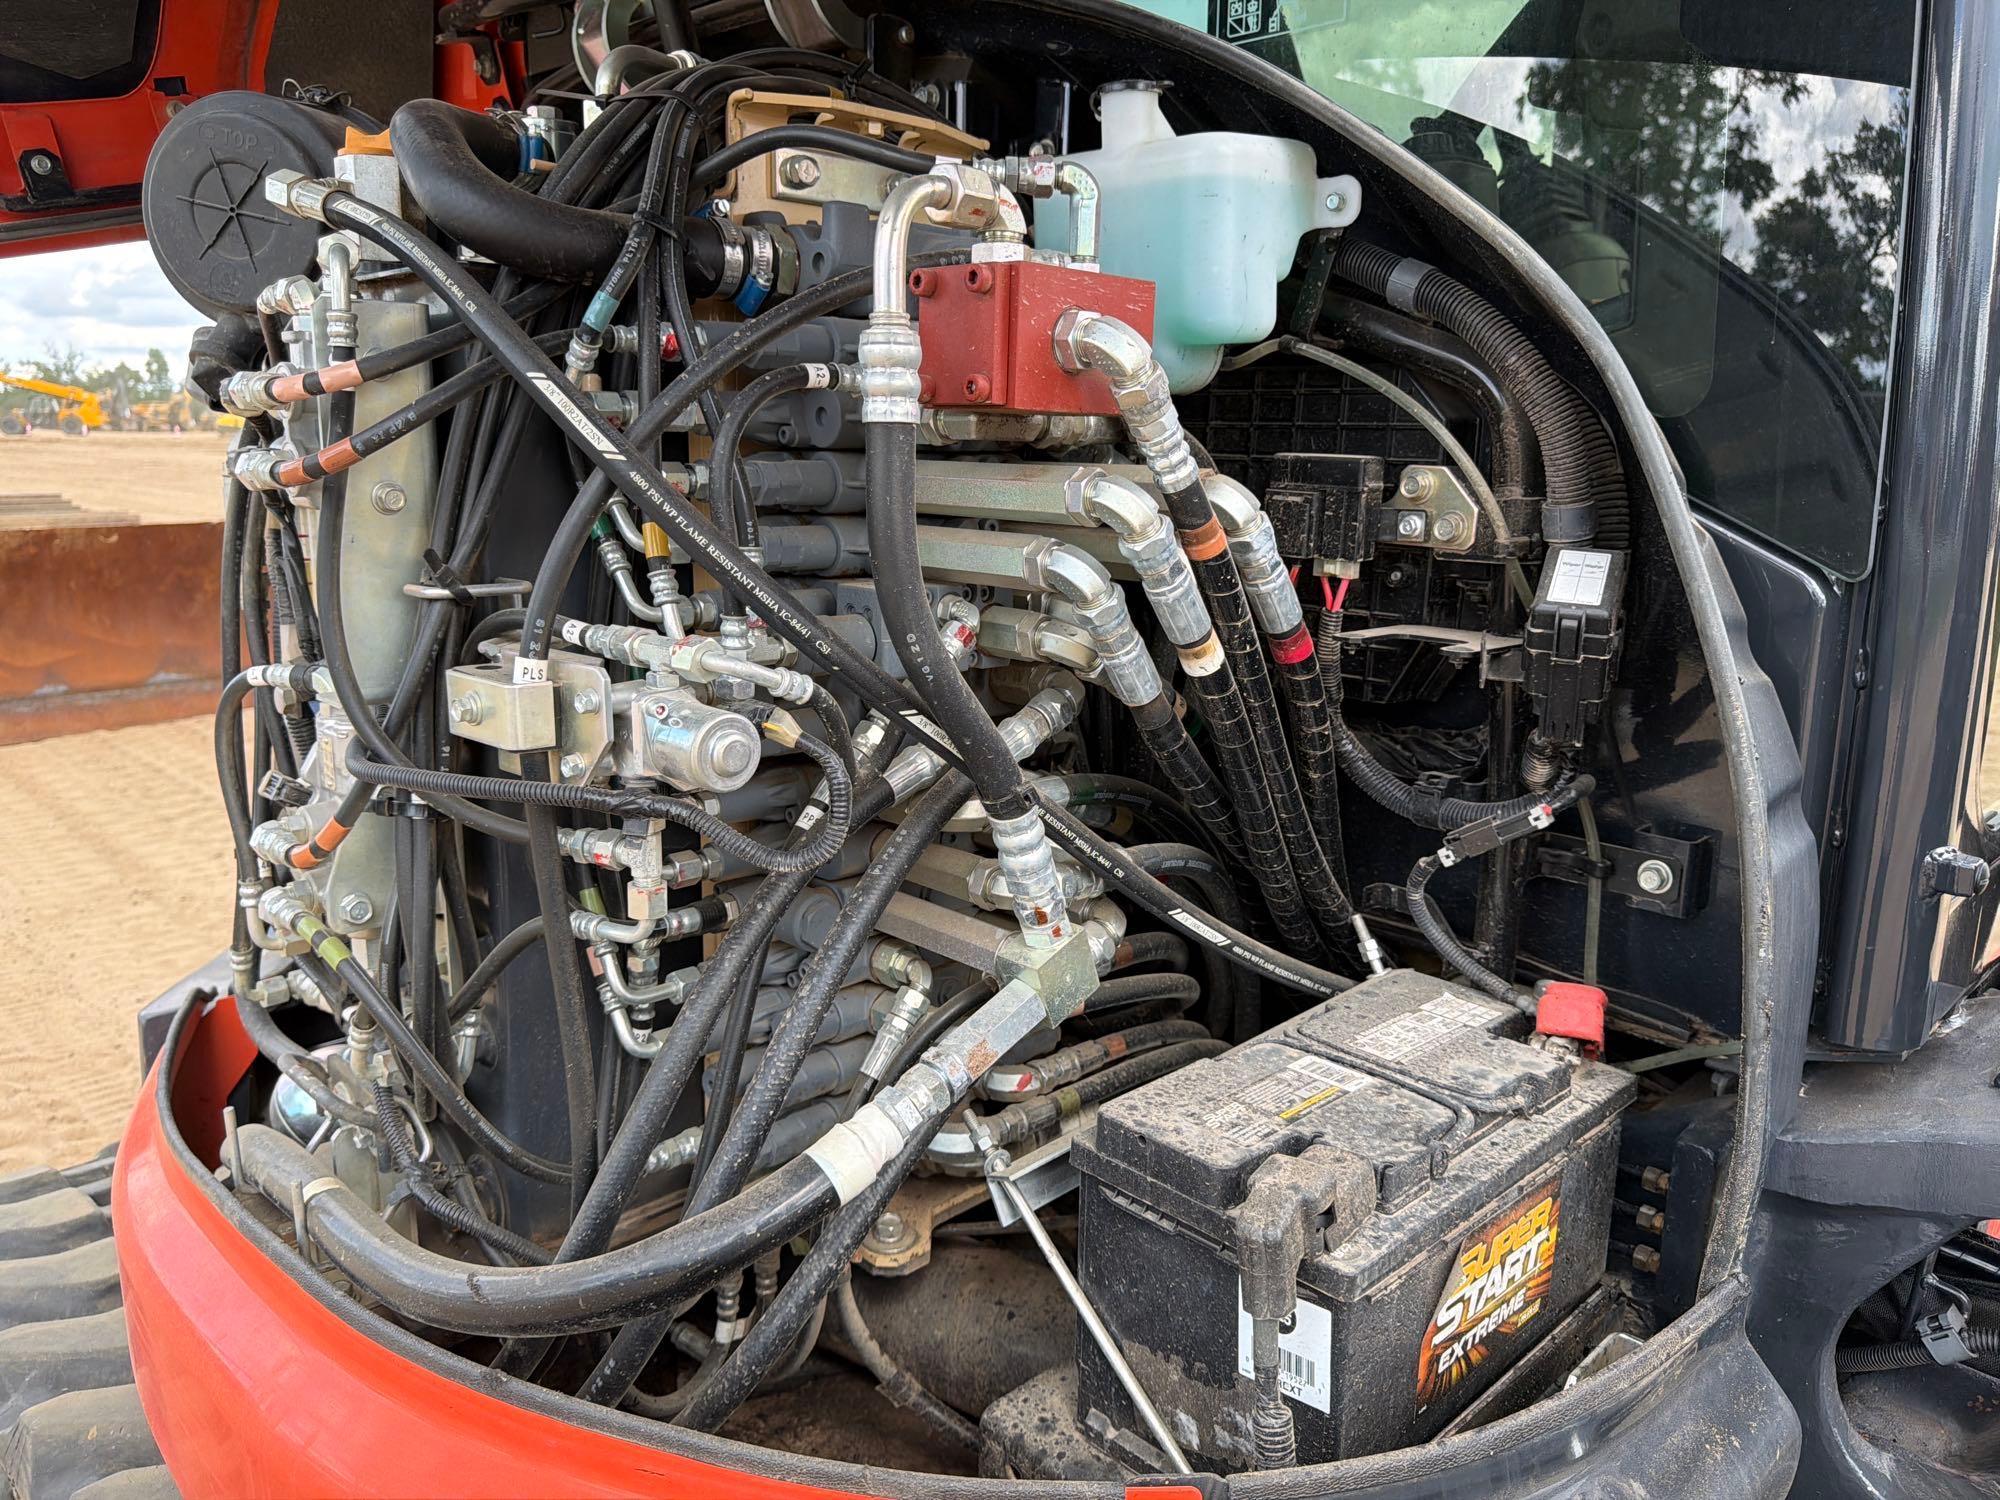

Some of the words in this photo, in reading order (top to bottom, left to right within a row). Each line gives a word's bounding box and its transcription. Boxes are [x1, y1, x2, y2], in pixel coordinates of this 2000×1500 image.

[222, 127, 258, 149] TOP
[413, 245, 437, 271] RESISTANT
[433, 266, 448, 283] MSHA
[465, 300, 477, 312] CSI
[557, 397, 604, 446] 100R2AT/2SN
[629, 469, 649, 492] 4800
[646, 488, 664, 506] PSI
[661, 501, 680, 520] WP
[675, 514, 709, 551] FLAME
[706, 543, 756, 593] RESISTANT
[752, 586, 781, 614] MSHA
[778, 609, 812, 639] IC-84/41
[815, 639, 833, 656] CSI
[521, 666, 544, 681] PLS
[1044, 812, 1077, 841] RESISTANT
[1073, 836, 1093, 856] MSHA
[1113, 866, 1125, 879] CSI
[1258, 958, 1276, 972] FLAME
[1273, 965, 1301, 983] RESISTANT
[1460, 1196, 1553, 1282] SUPER
[1431, 1229, 1550, 1349] START
[1437, 1287, 1527, 1374] EXTREME
